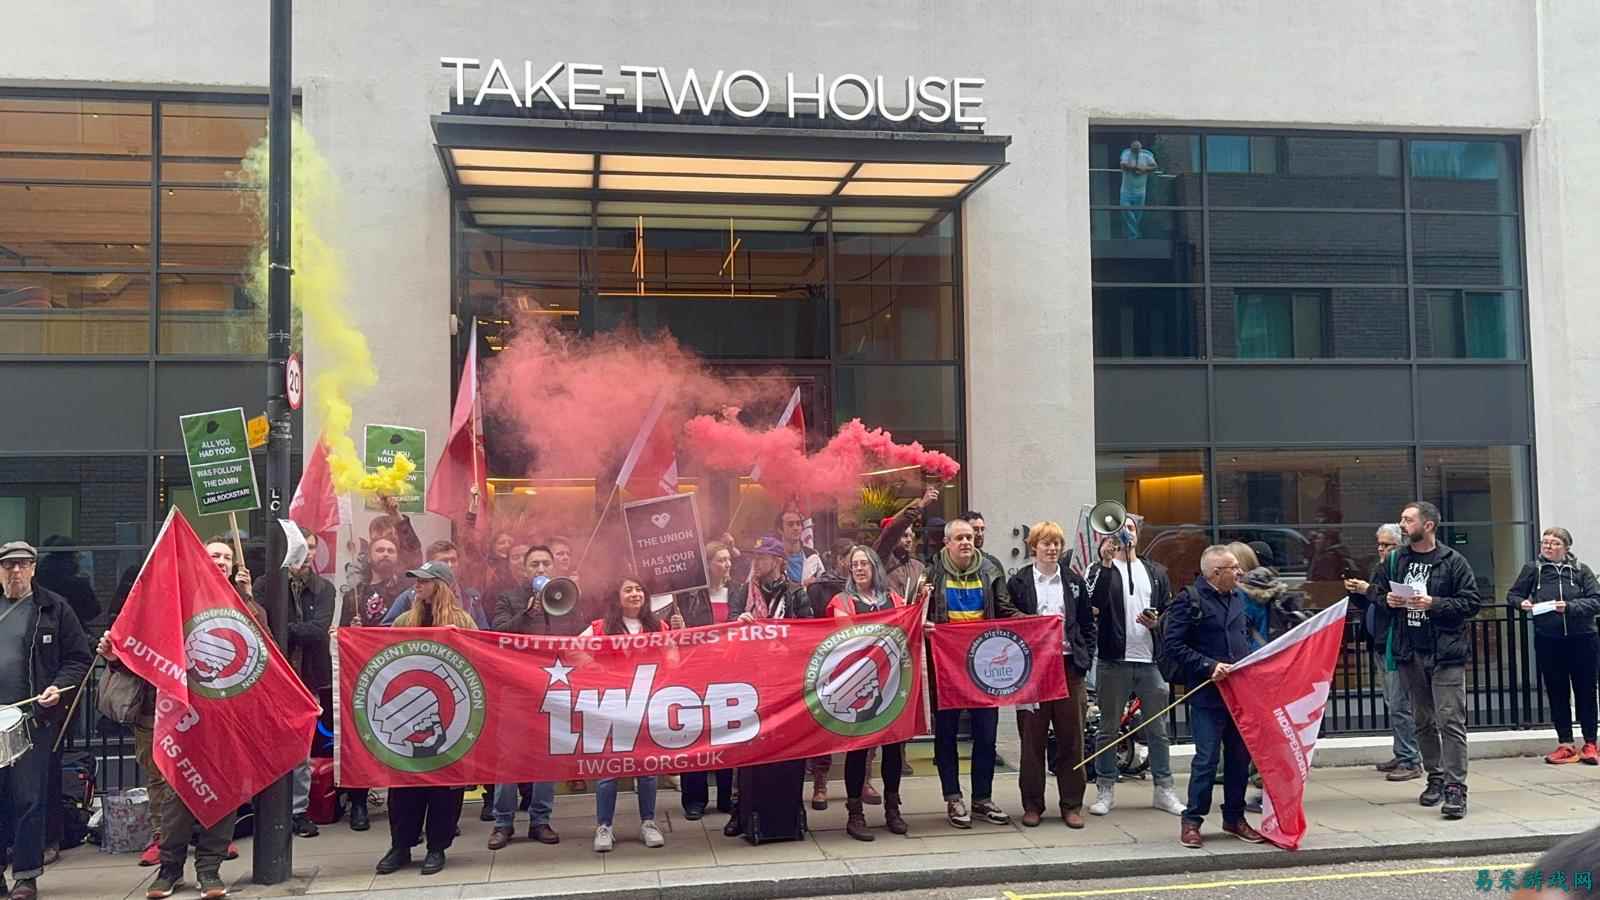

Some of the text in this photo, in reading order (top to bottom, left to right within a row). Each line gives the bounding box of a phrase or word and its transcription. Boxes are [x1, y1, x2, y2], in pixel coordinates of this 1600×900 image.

[440, 57, 987, 123] TAKE-TWO HOUSE
[289, 370, 300, 394] 20
[199, 446, 237, 458] HAD TO DO
[201, 438, 230, 449] ALL YOU
[377, 456, 393, 464] HAD
[382, 449, 395, 457] ALL
[196, 465, 242, 477] WAS FOLLOW
[203, 477, 239, 488] THE DAMN
[638, 529, 694, 549] THE UNION
[642, 550, 696, 568] HAS YOUR
[654, 562, 688, 576] BACK!
[499, 624, 791, 651] PUTTING WORKERS FIRST
[354, 642, 484, 710] INDEPENDENT WORKERS UNION
[576, 750, 725, 775] IWGB.ORG.UK
[176, 758, 218, 805] FIRST
